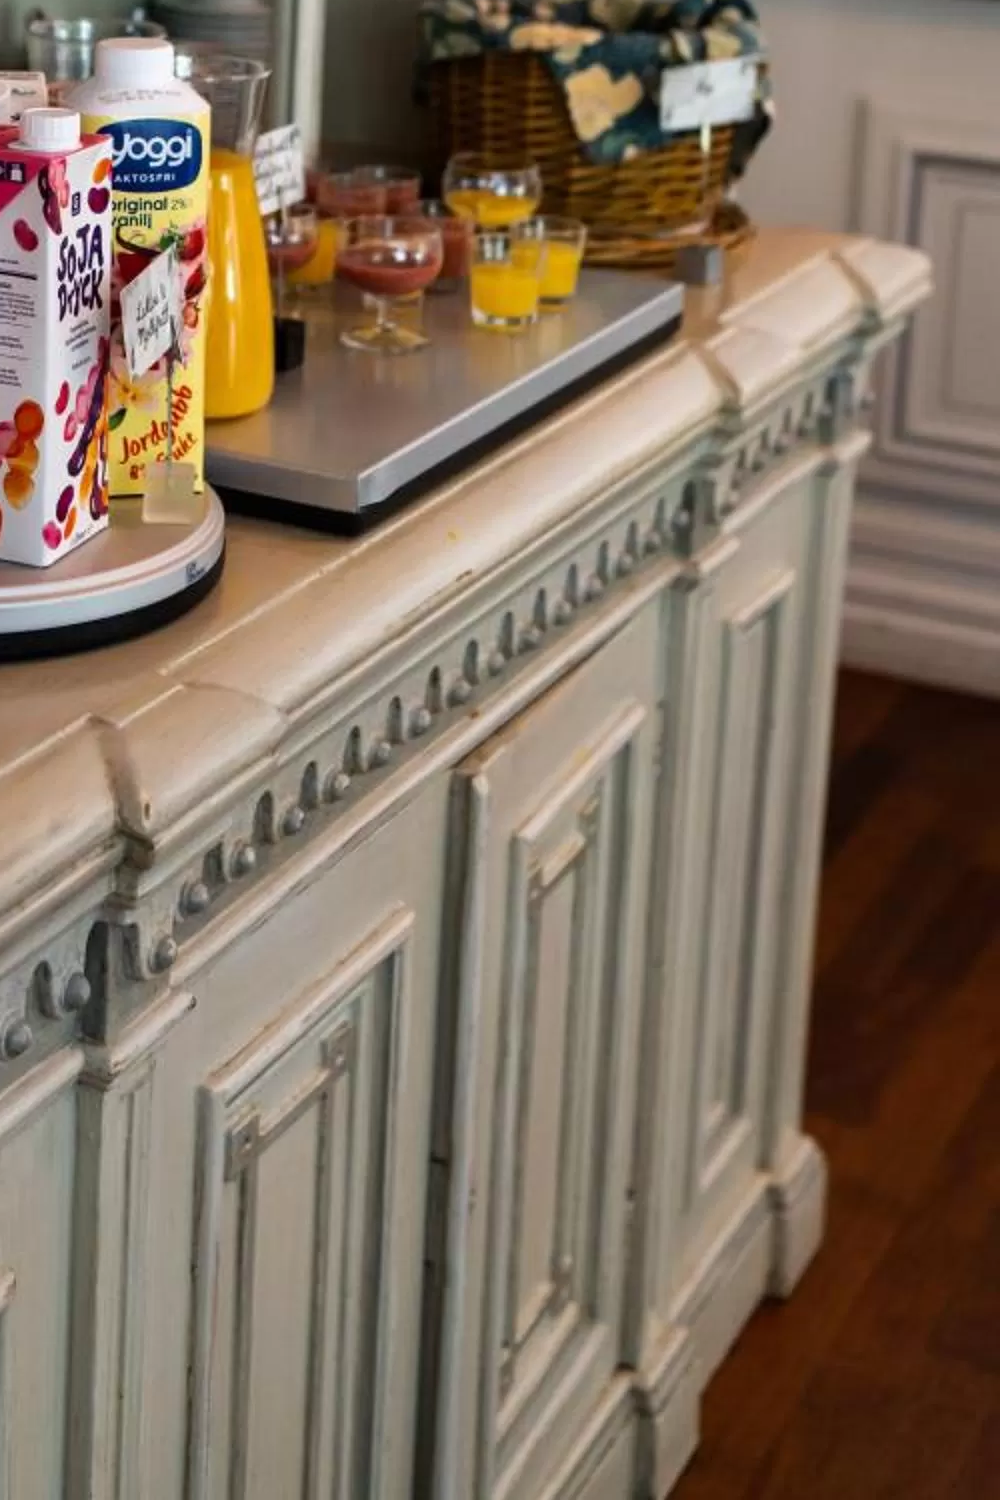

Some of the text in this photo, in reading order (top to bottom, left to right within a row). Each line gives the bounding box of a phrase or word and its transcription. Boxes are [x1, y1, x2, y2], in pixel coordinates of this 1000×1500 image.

[111, 128, 193, 167] yoggi
[111, 173, 176, 184] AKTOSFRI
[111, 198, 168, 214] original
[111, 213, 152, 228] vanilj
